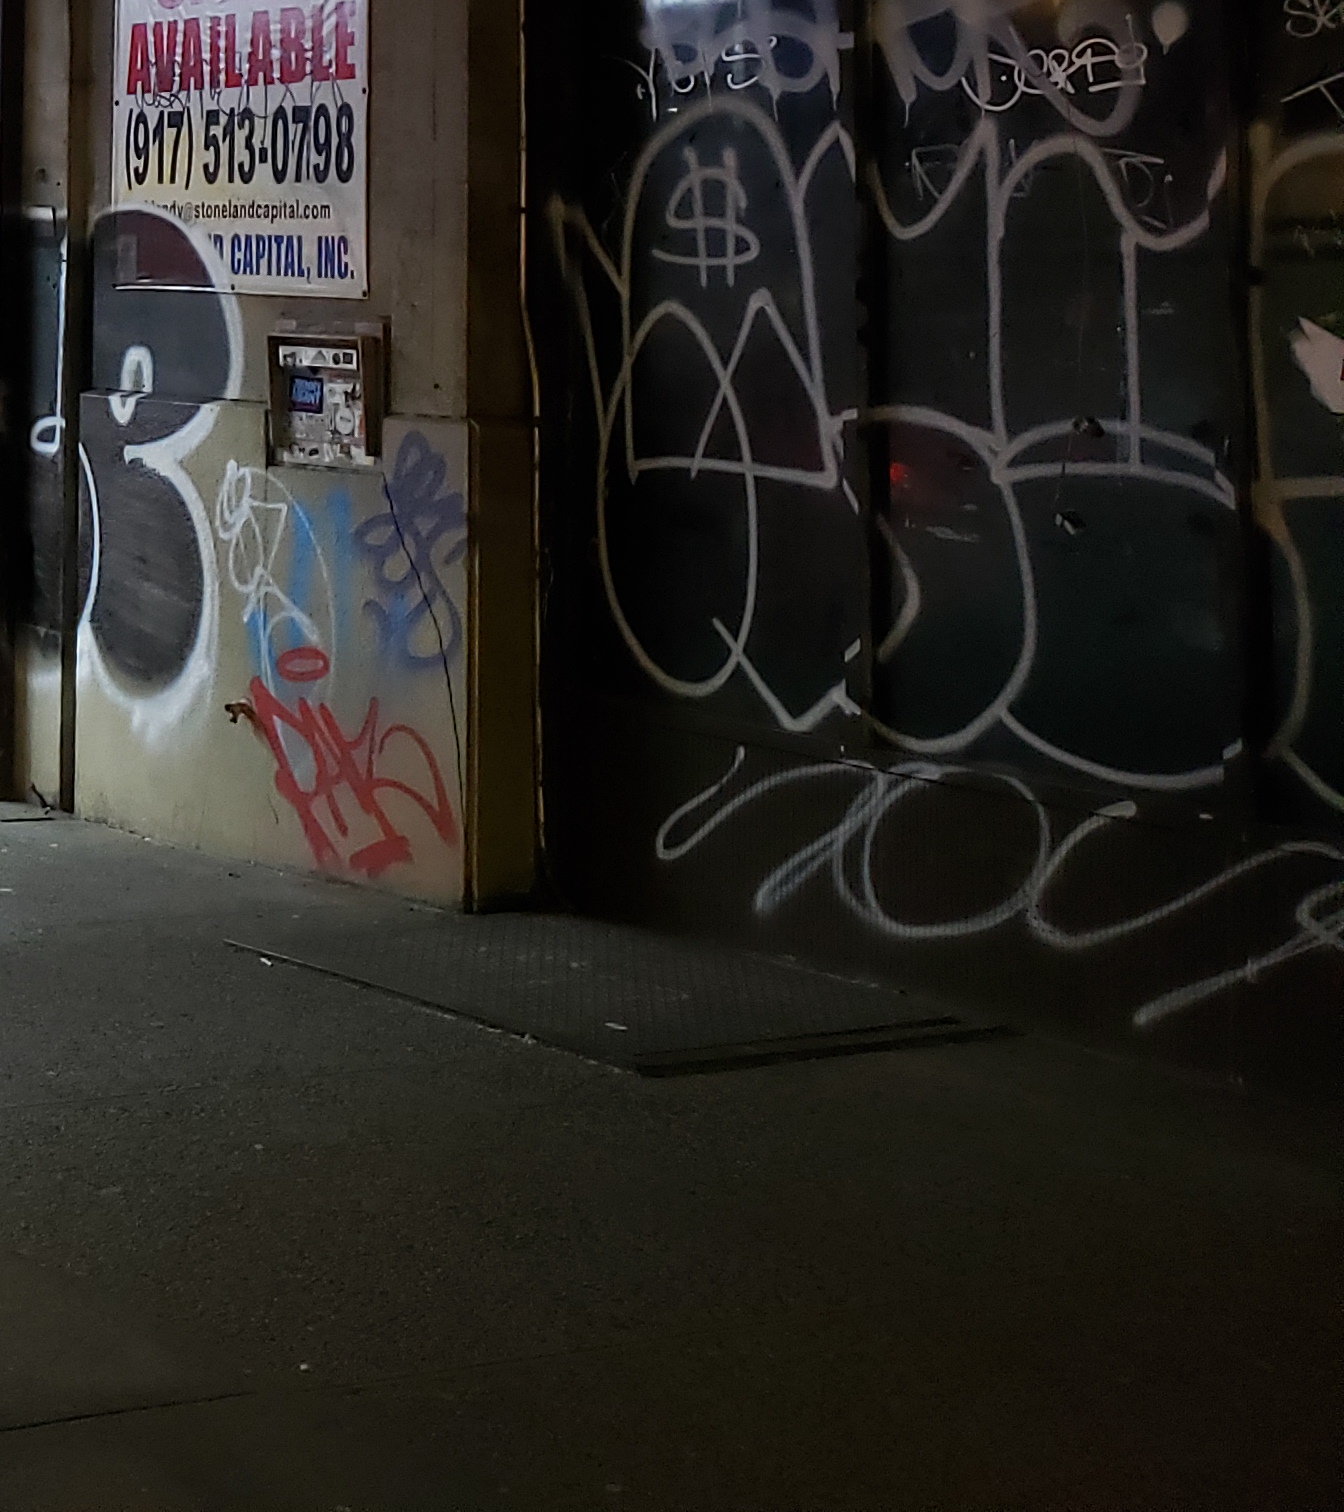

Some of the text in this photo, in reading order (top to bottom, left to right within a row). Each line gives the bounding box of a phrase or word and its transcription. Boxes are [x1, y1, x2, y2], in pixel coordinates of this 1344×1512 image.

[126, 0, 357, 95] AVAILABLE
[124, 101, 355, 190] (917) 513-0798
[317, 235, 355, 279] INC.
